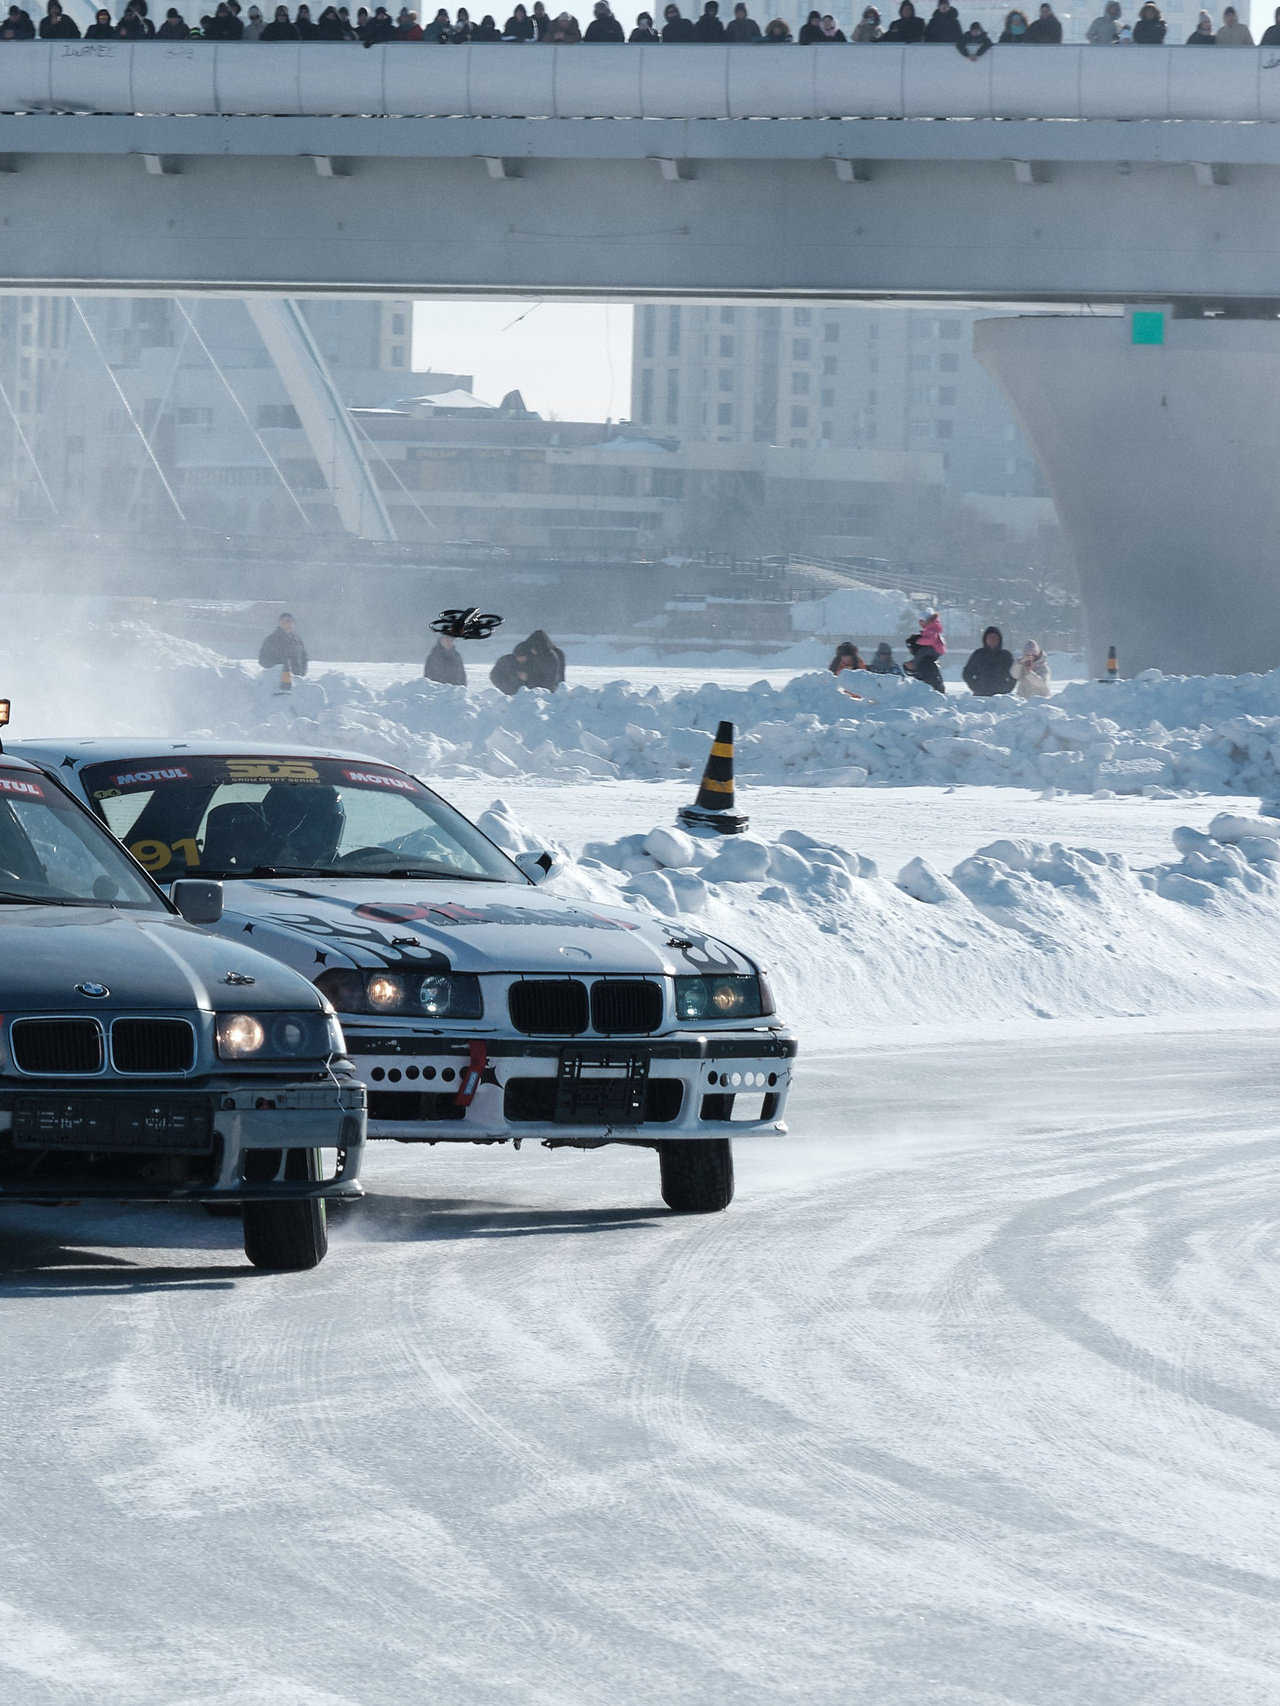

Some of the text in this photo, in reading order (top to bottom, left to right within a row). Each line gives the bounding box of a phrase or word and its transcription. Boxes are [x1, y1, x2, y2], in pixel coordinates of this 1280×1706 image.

[116, 768, 188, 785] MOTUL
[349, 771, 415, 790] MOTUL
[129, 837, 201, 871] 91
